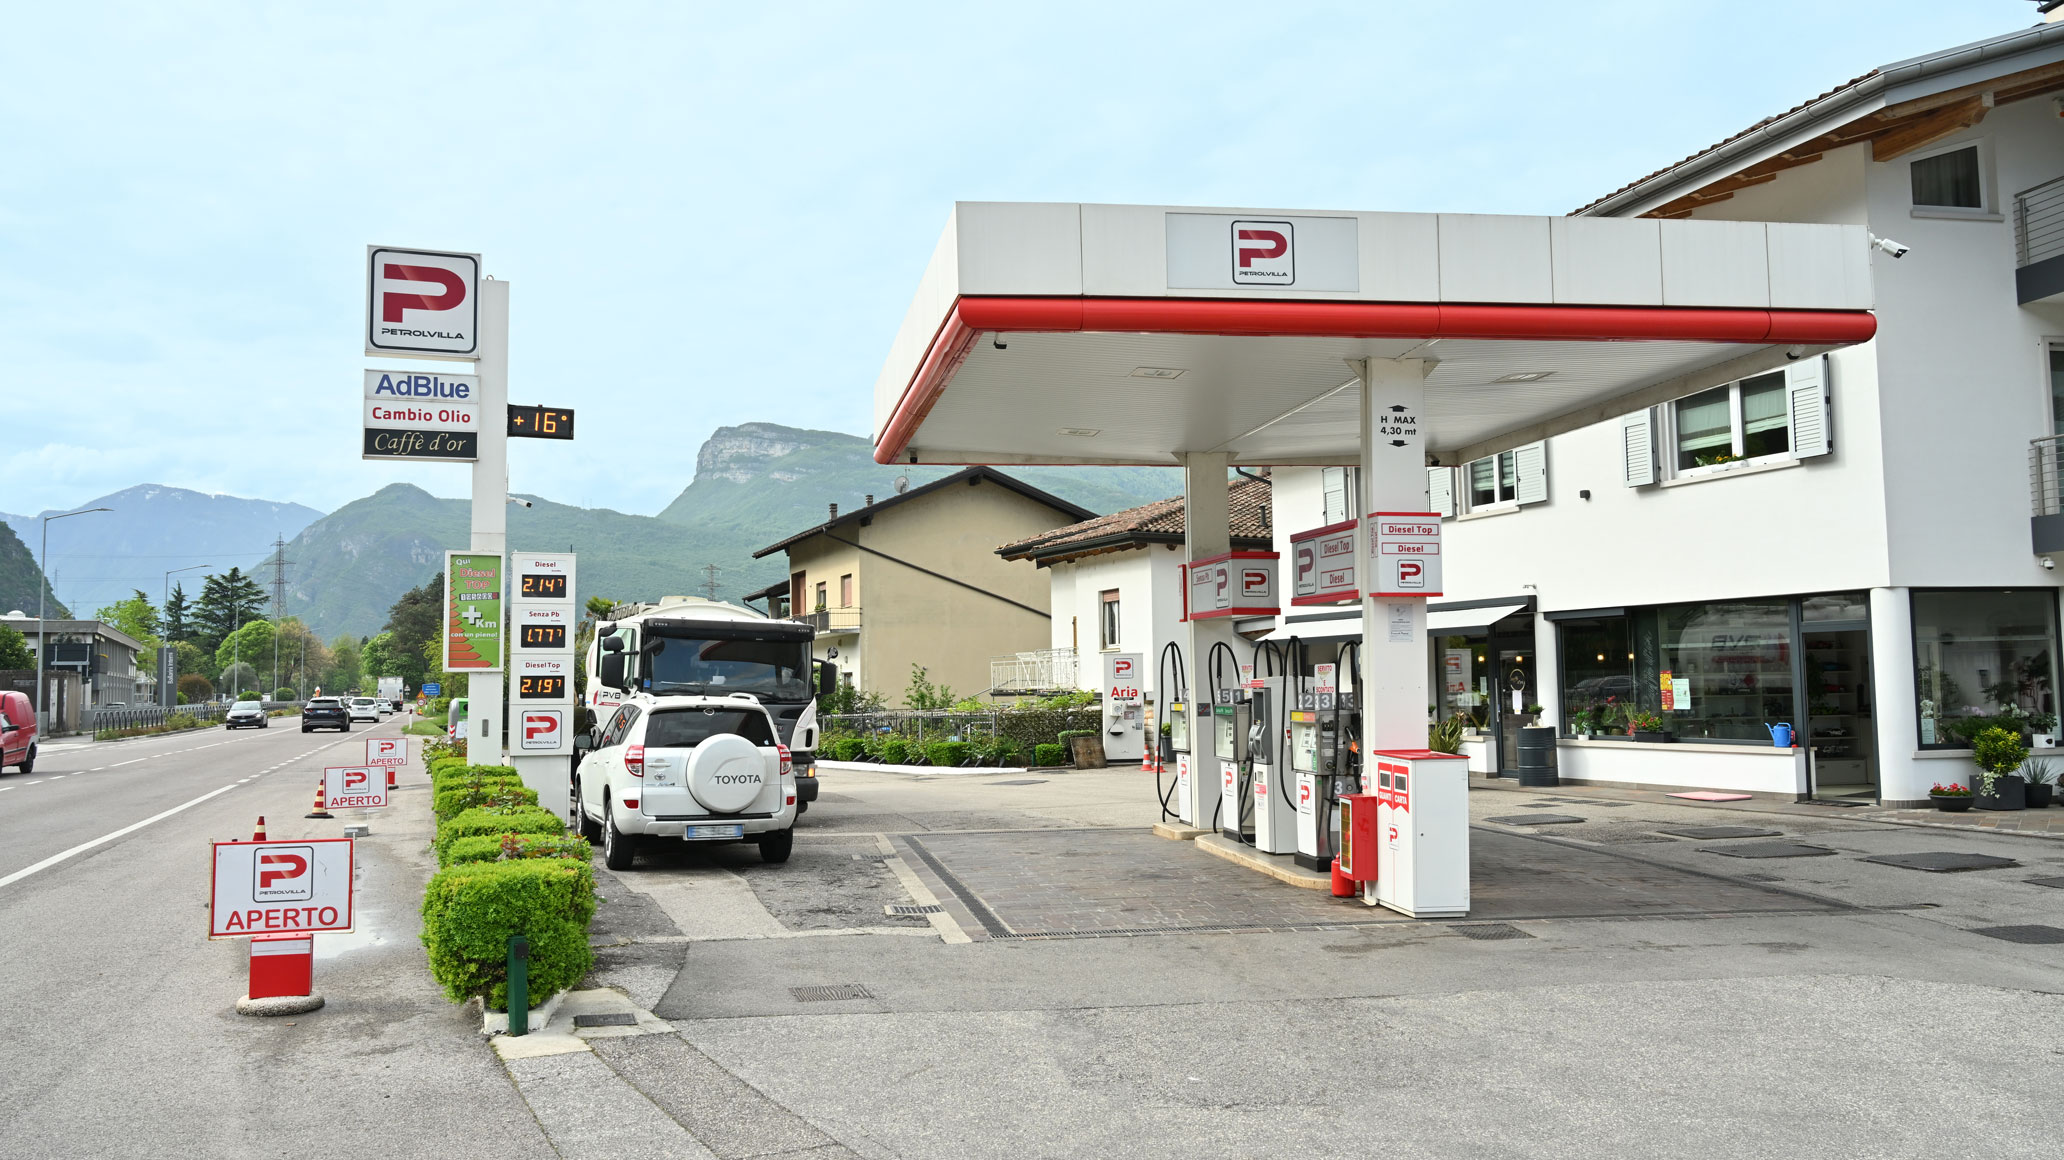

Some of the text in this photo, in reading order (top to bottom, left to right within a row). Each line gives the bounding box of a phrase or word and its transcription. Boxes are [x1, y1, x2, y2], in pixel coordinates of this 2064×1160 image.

[1238, 229, 1288, 268] P
[383, 263, 466, 323] P
[381, 327, 464, 340] PETROLVILLA
[375, 373, 470, 399] AdBlue
[372, 406, 471, 423] Cambio Olio
[1380, 415, 1416, 425] H MAX
[1380, 426, 1417, 436] 4,30 mt
[374, 431, 467, 455] Caffè d'or
[1388, 525, 1433, 536] Diesel Top
[1323, 540, 1350, 555] Diesel Top
[1398, 544, 1424, 553] Diesel
[455, 558, 471, 566] Qui
[459, 567, 497, 578] Diesel
[1329, 571, 1345, 585] Diesel
[463, 579, 491, 590] TOP
[475, 618, 498, 629] Km
[475, 631, 498, 639] pieno!
[1317, 664, 1333, 672] SERVITO
[1110, 685, 1139, 698] Aria
[1222, 690, 1230, 702] 5
[1235, 690, 1241, 702] 1
[1304, 694, 1314, 708] 2
[1321, 694, 1331, 708] 3
[370, 757, 404, 765] APERTO
[715, 774, 762, 785] TOYOTA
[1334, 781, 1343, 795] 3
[330, 795, 382, 807] APERTO
[225, 906, 339, 931] APERTO
